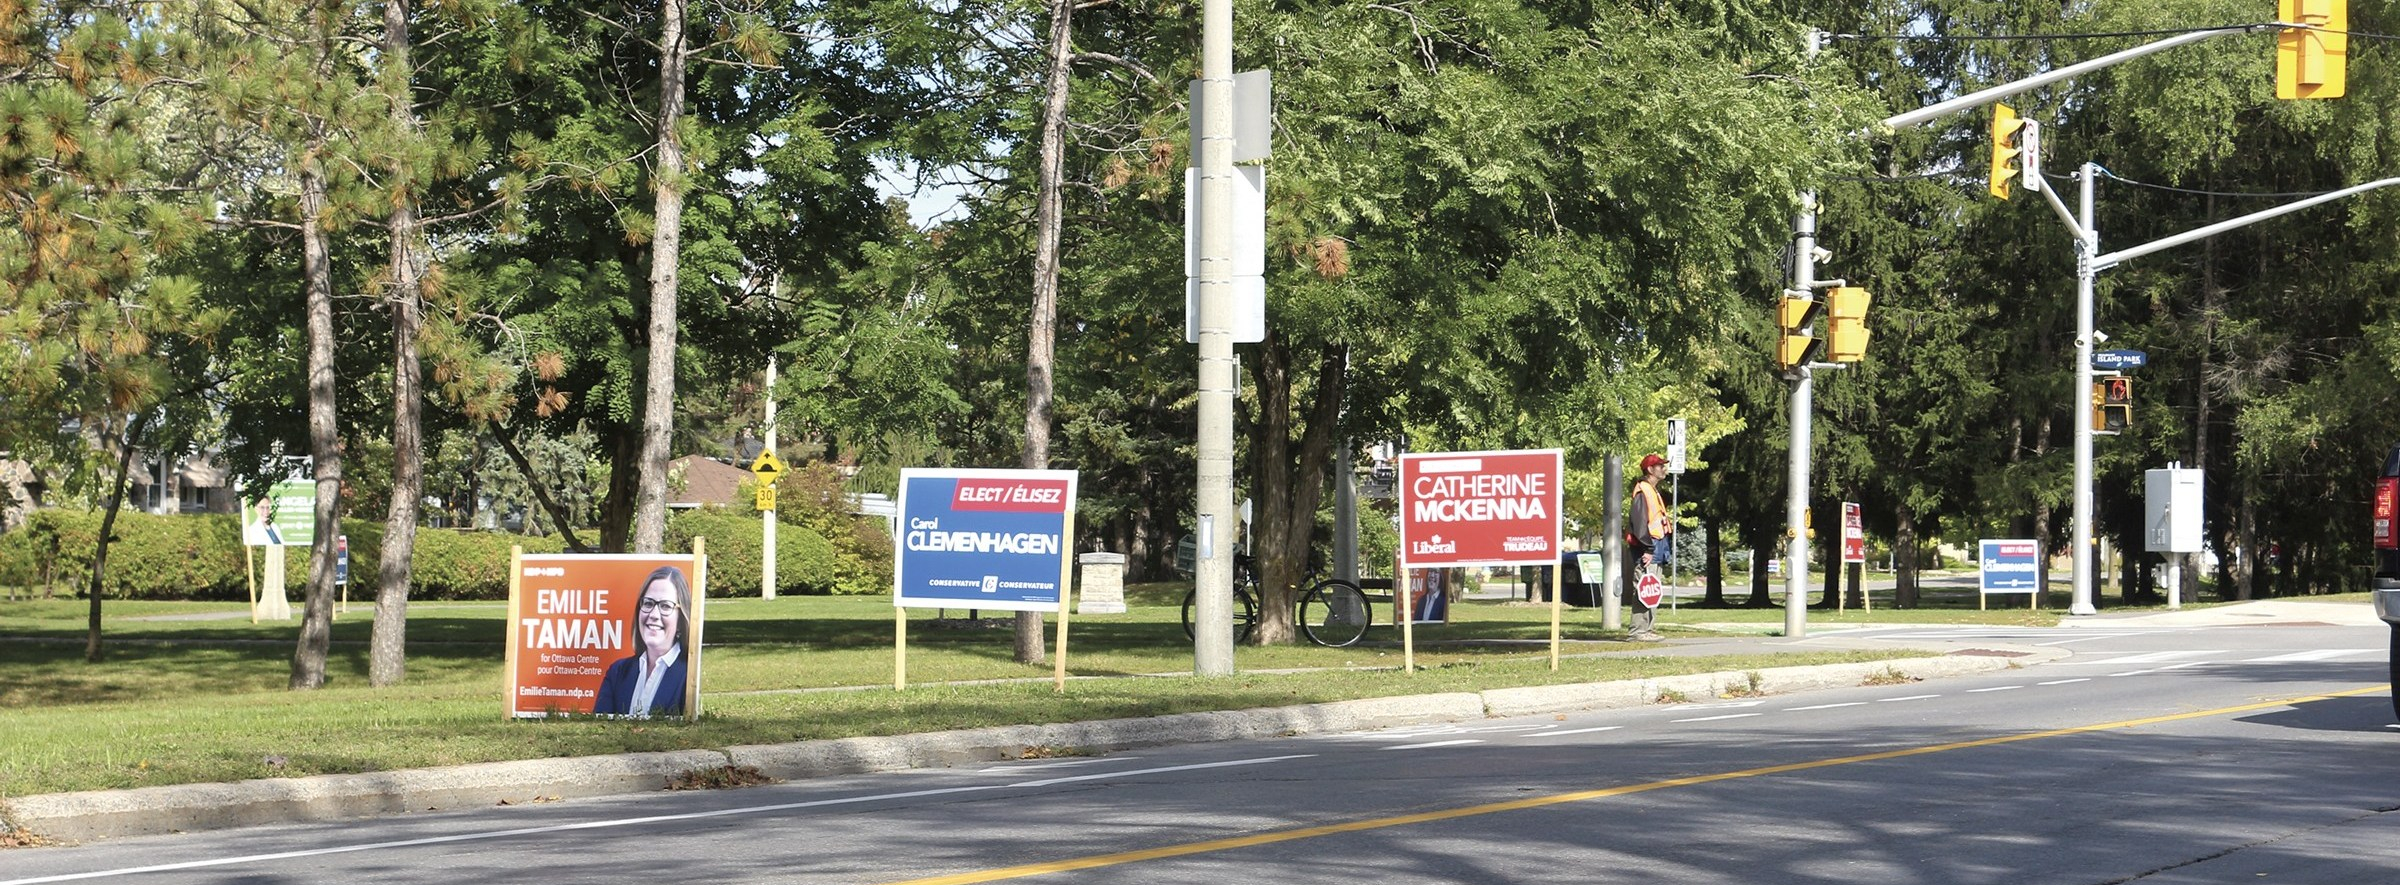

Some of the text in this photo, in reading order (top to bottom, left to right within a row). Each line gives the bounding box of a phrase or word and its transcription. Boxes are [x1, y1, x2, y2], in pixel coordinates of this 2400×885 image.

[1414, 473, 1546, 499] CATHERINE
[760, 490, 773, 501] 30
[959, 487, 1003, 502] ELECT
[1012, 484, 1063, 503] ÉLISEZ
[1414, 497, 1547, 523] MCKENNA
[911, 517, 939, 530] Carol
[907, 530, 1059, 555] CLEMENHAGEN
[1503, 541, 1548, 552] TRUDEAU
[929, 579, 980, 588] CONSERVATIVE
[998, 581, 1055, 590] CONSERVATEUR
[1641, 584, 1660, 598] STOP
[537, 589, 609, 614] EMILIE
[521, 618, 623, 650] TAMAN
[540, 653, 600, 664] for Ottawa Centre
[537, 665, 603, 676] pour Ottawa-Centre
[519, 685, 595, 700] EmilieTaman.ndp.ca
